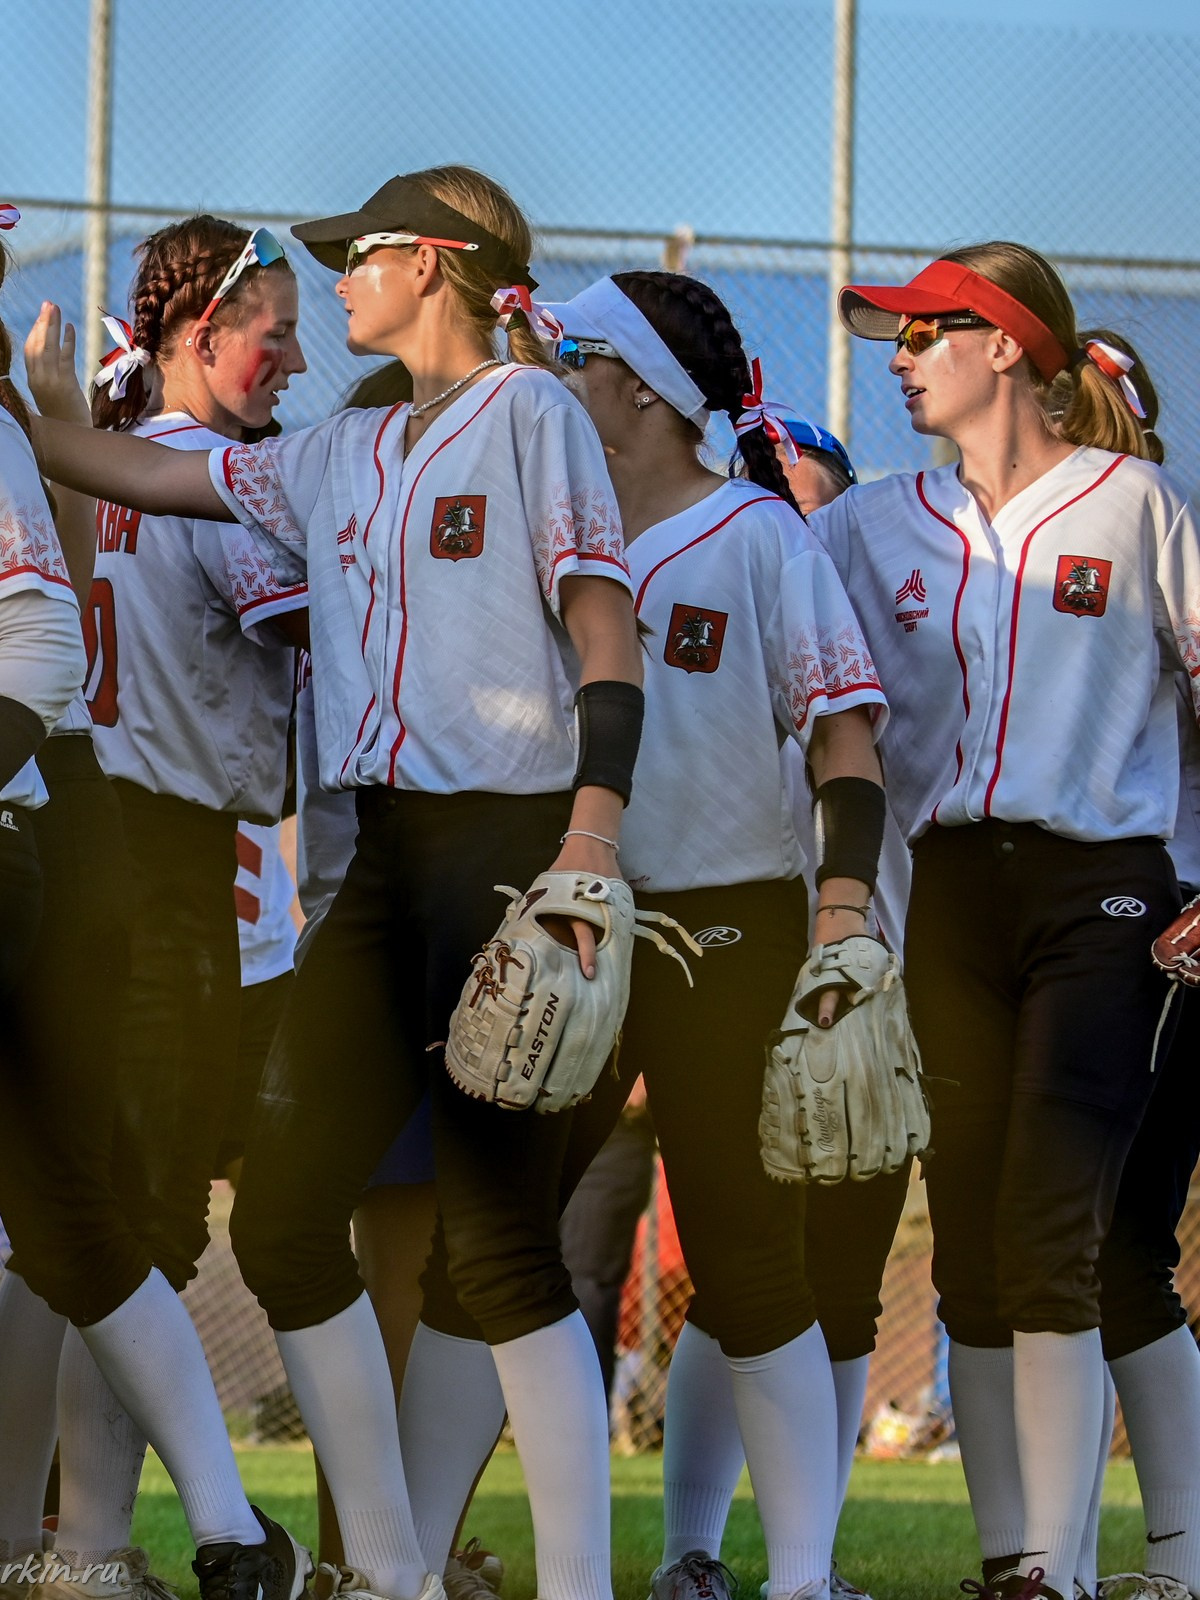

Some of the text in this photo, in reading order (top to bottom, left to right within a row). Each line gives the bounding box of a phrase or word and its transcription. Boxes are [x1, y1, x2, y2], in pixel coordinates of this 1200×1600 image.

[1108, 898, 1140, 915] R
[697, 927, 733, 946] R
[520, 992, 560, 1081] EASTON
